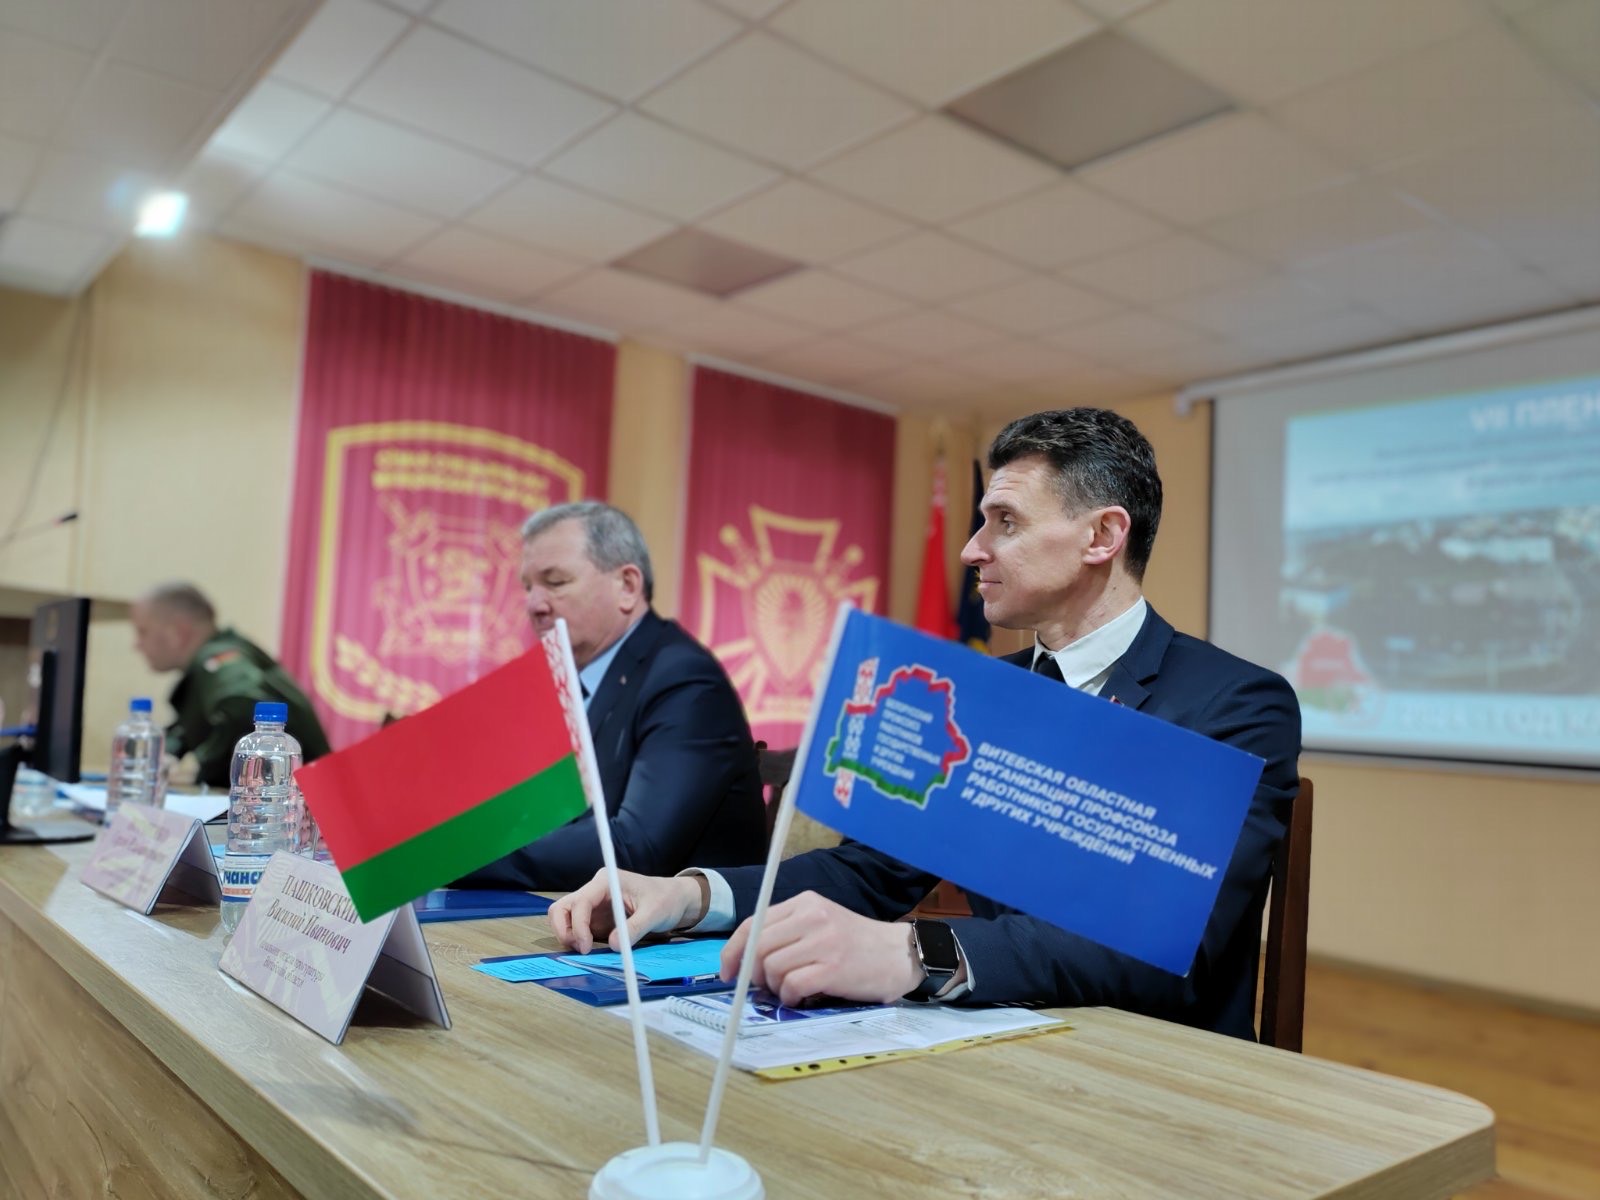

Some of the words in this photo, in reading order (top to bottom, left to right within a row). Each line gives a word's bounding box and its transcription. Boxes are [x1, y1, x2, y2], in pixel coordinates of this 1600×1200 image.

[973, 757, 1080, 808] ОРГАНИЗАЦИЯ
[1079, 799, 1178, 847] ПРОФСОЮЗА
[978, 742, 1066, 785] ВИТЕБСКАЯ
[1065, 776, 1157, 820] ОБЛАСТНАЯ
[960, 786, 976, 801] И
[971, 792, 1034, 824] ДРУГИХ
[1031, 814, 1136, 865] УЧРЕЖДЕНИЙ
[966, 771, 1064, 819] РАБОТНИКОВ
[1063, 810, 1218, 879] ГОСУДАРСТВЕННЫХ
[266, 898, 306, 932] Василий
[301, 914, 352, 954] Иванович
